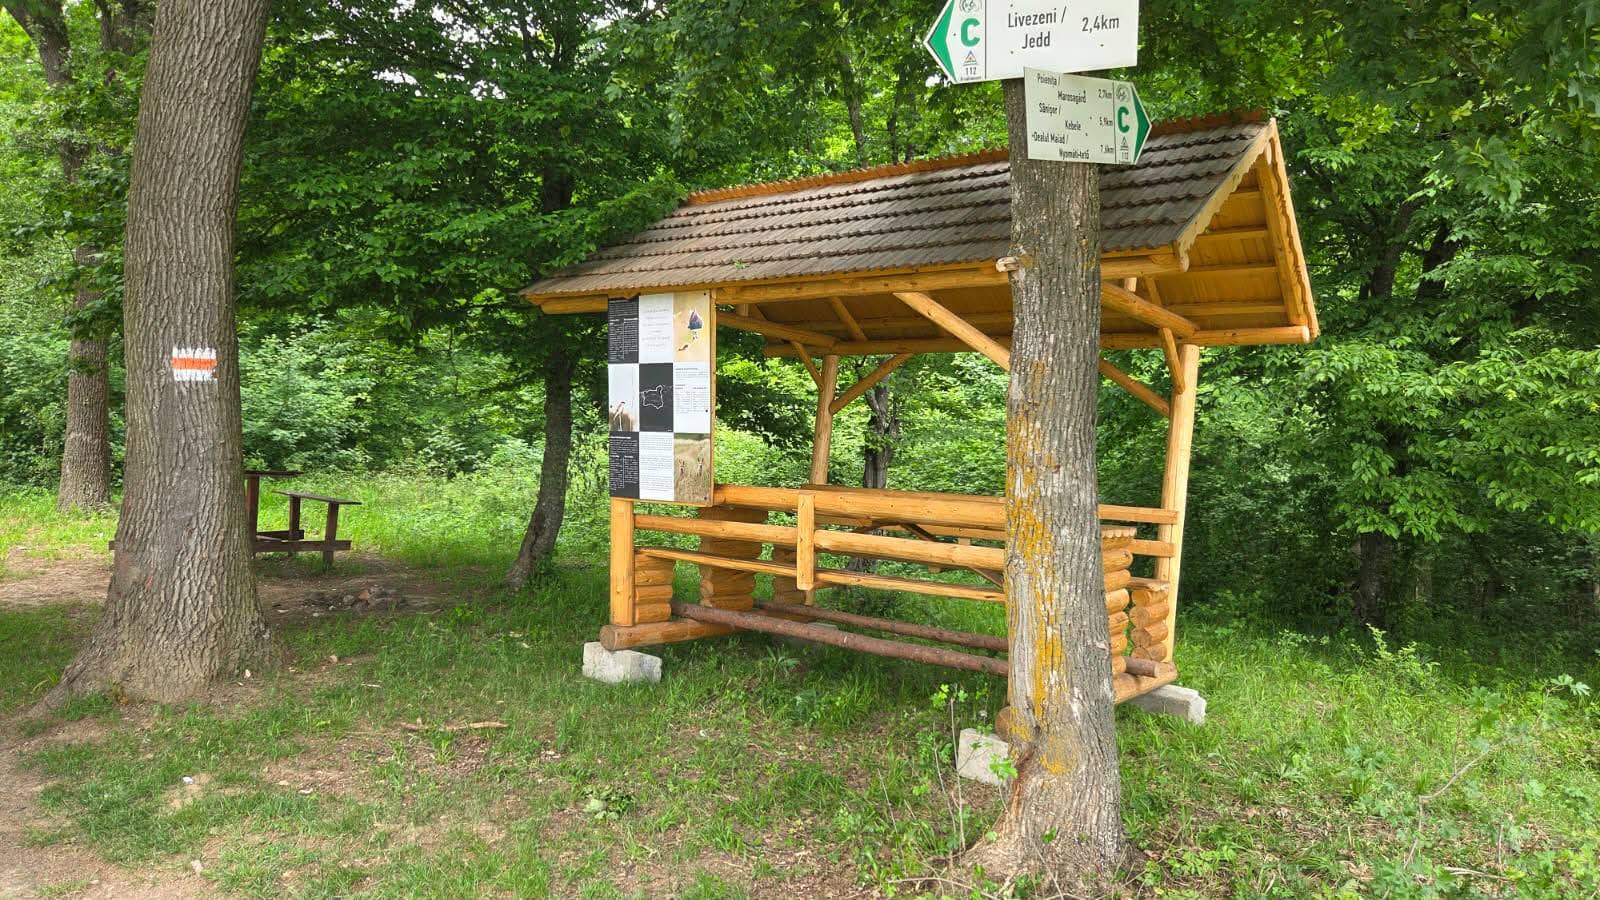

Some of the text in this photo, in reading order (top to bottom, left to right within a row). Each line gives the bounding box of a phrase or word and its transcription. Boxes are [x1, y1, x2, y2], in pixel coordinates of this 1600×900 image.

[1008, 6, 1067, 28] Livezeni /
[1082, 15, 1120, 32] 2,4km
[960, 18, 980, 46] C
[1022, 31, 1050, 49] Jedd
[966, 67, 977, 75] 112
[1118, 106, 1130, 133] C
